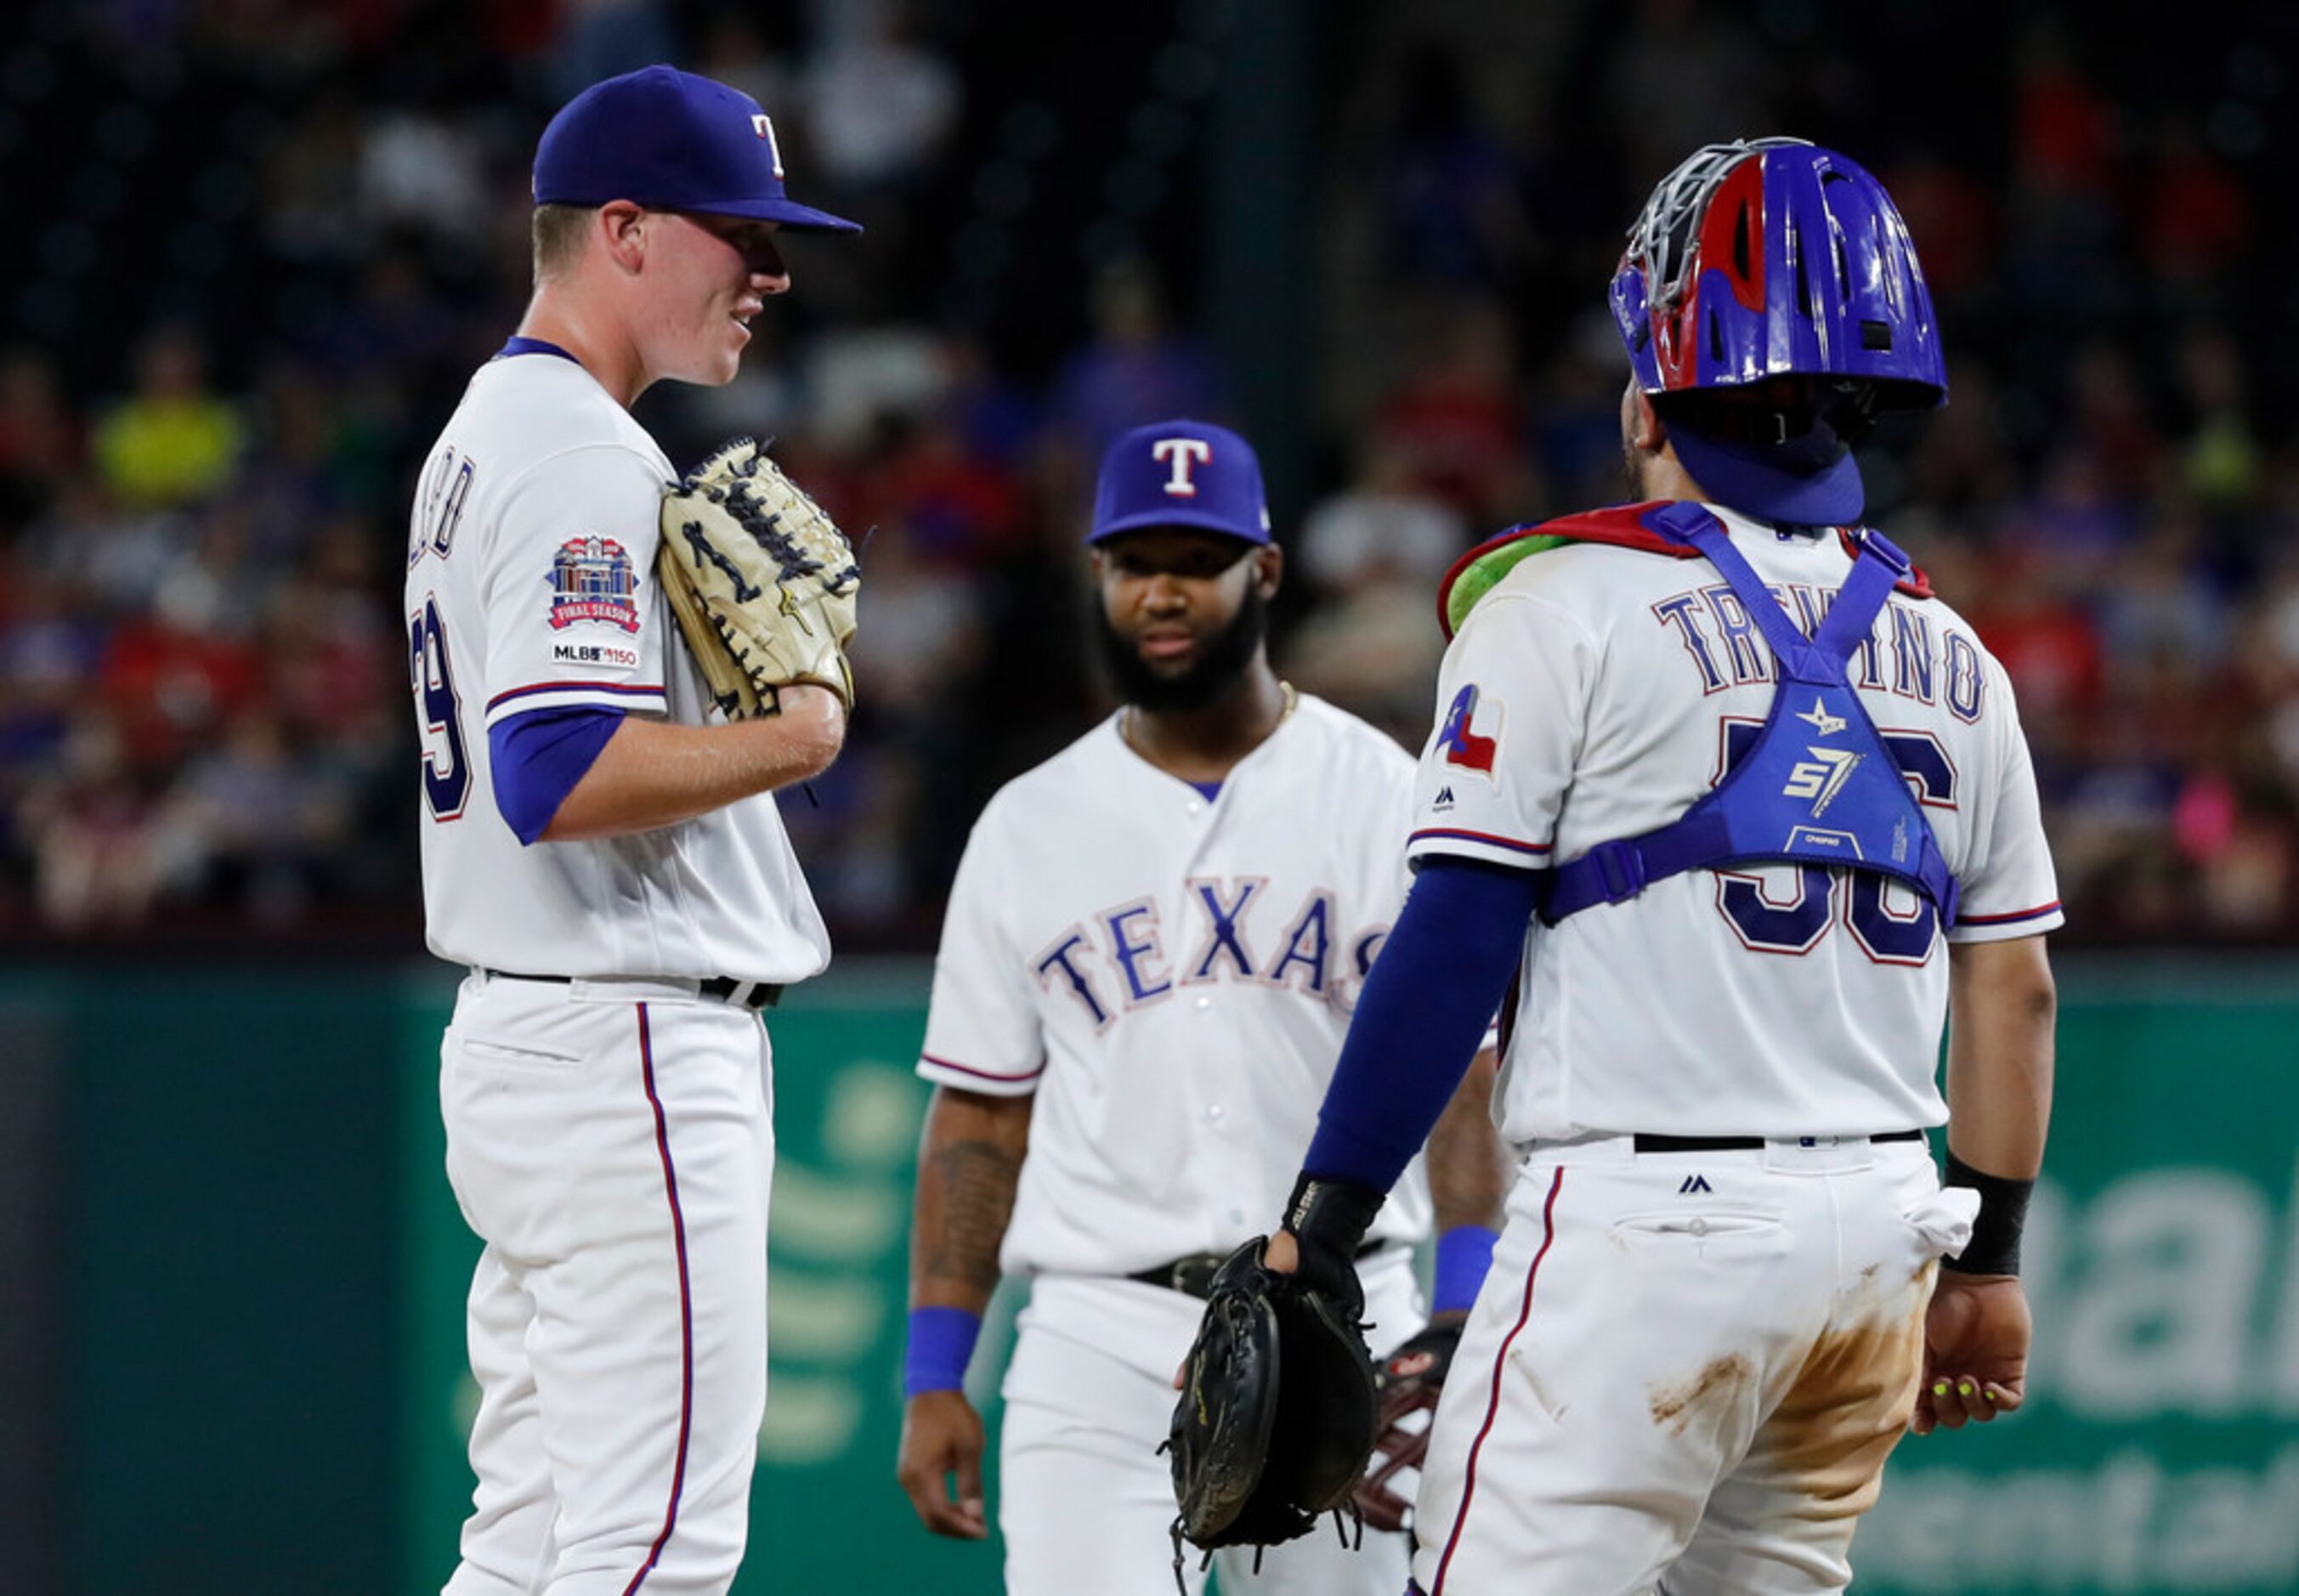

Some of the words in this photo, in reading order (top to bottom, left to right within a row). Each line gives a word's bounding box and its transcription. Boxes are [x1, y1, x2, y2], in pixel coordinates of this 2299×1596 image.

[751, 114, 784, 181] T
[1153, 439, 1210, 496] T
[557, 603, 588, 620] FINAL
[592, 603, 632, 623] SEASON
[554, 646, 589, 660] MLB
